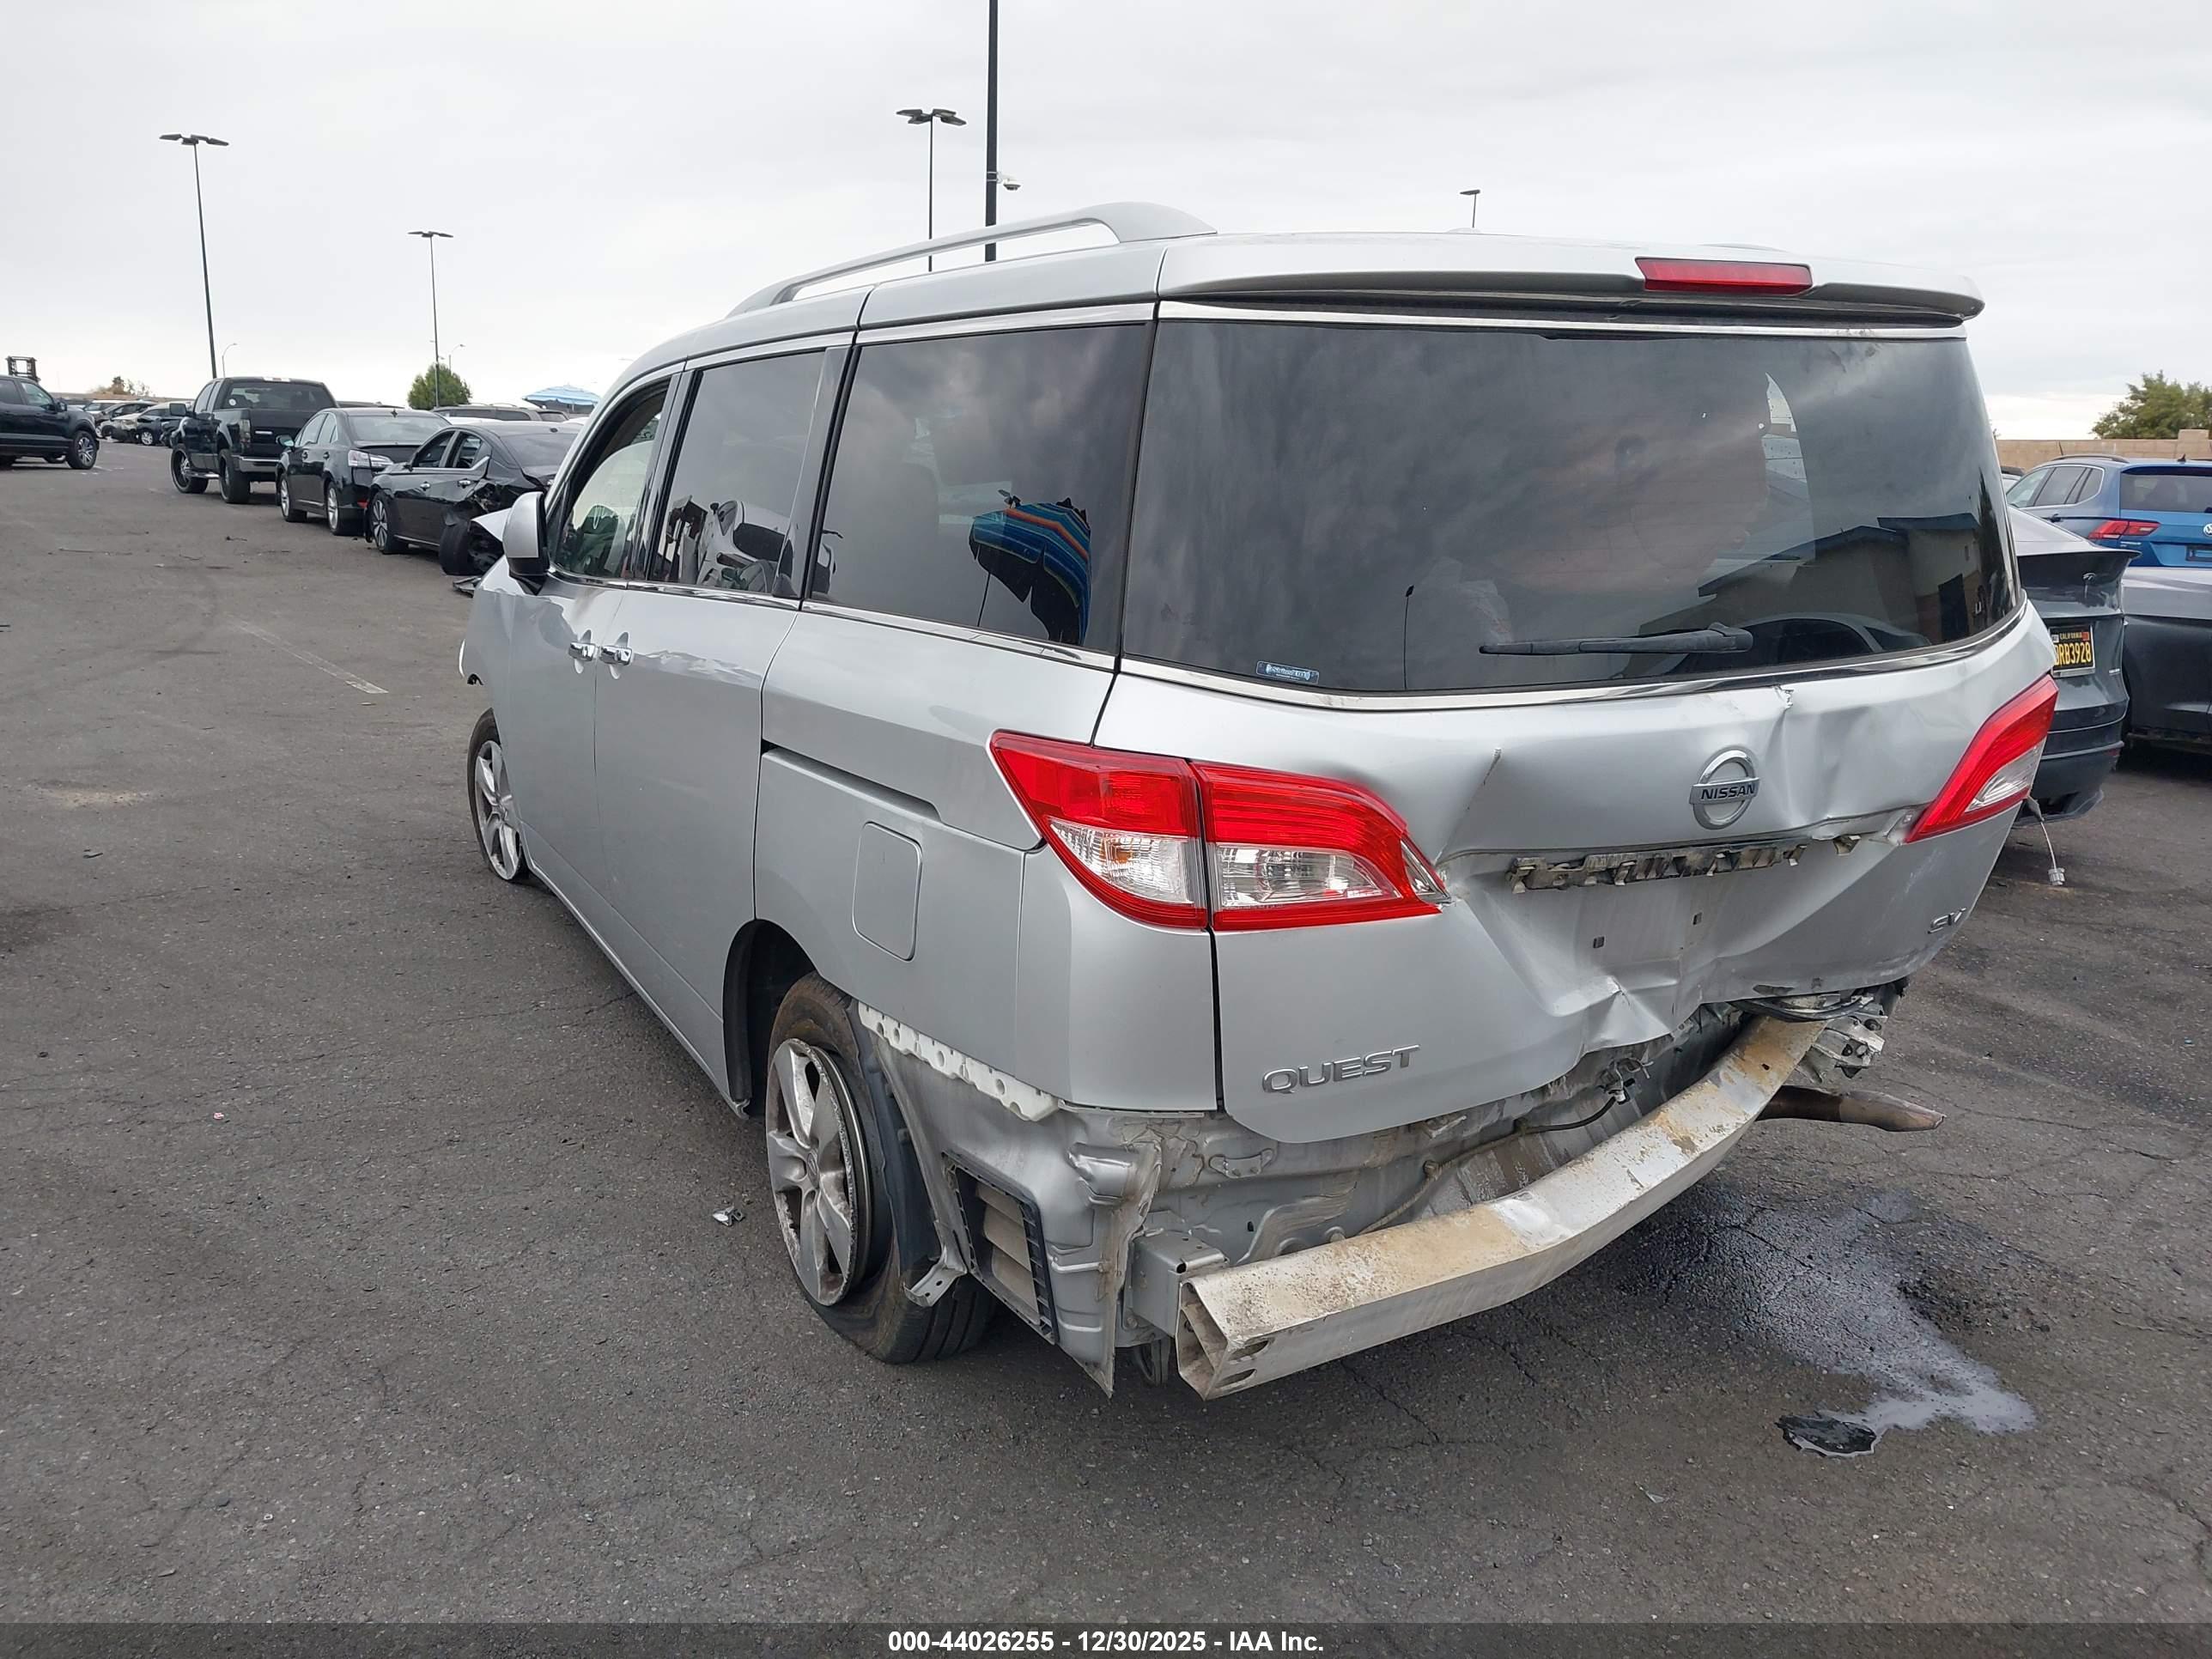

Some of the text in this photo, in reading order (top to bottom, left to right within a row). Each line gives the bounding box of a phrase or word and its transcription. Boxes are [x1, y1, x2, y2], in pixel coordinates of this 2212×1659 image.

[1701, 783, 1755, 800] NISSAN
[1928, 907, 1966, 934] SV
[1262, 1043, 1419, 1094] QUEST
